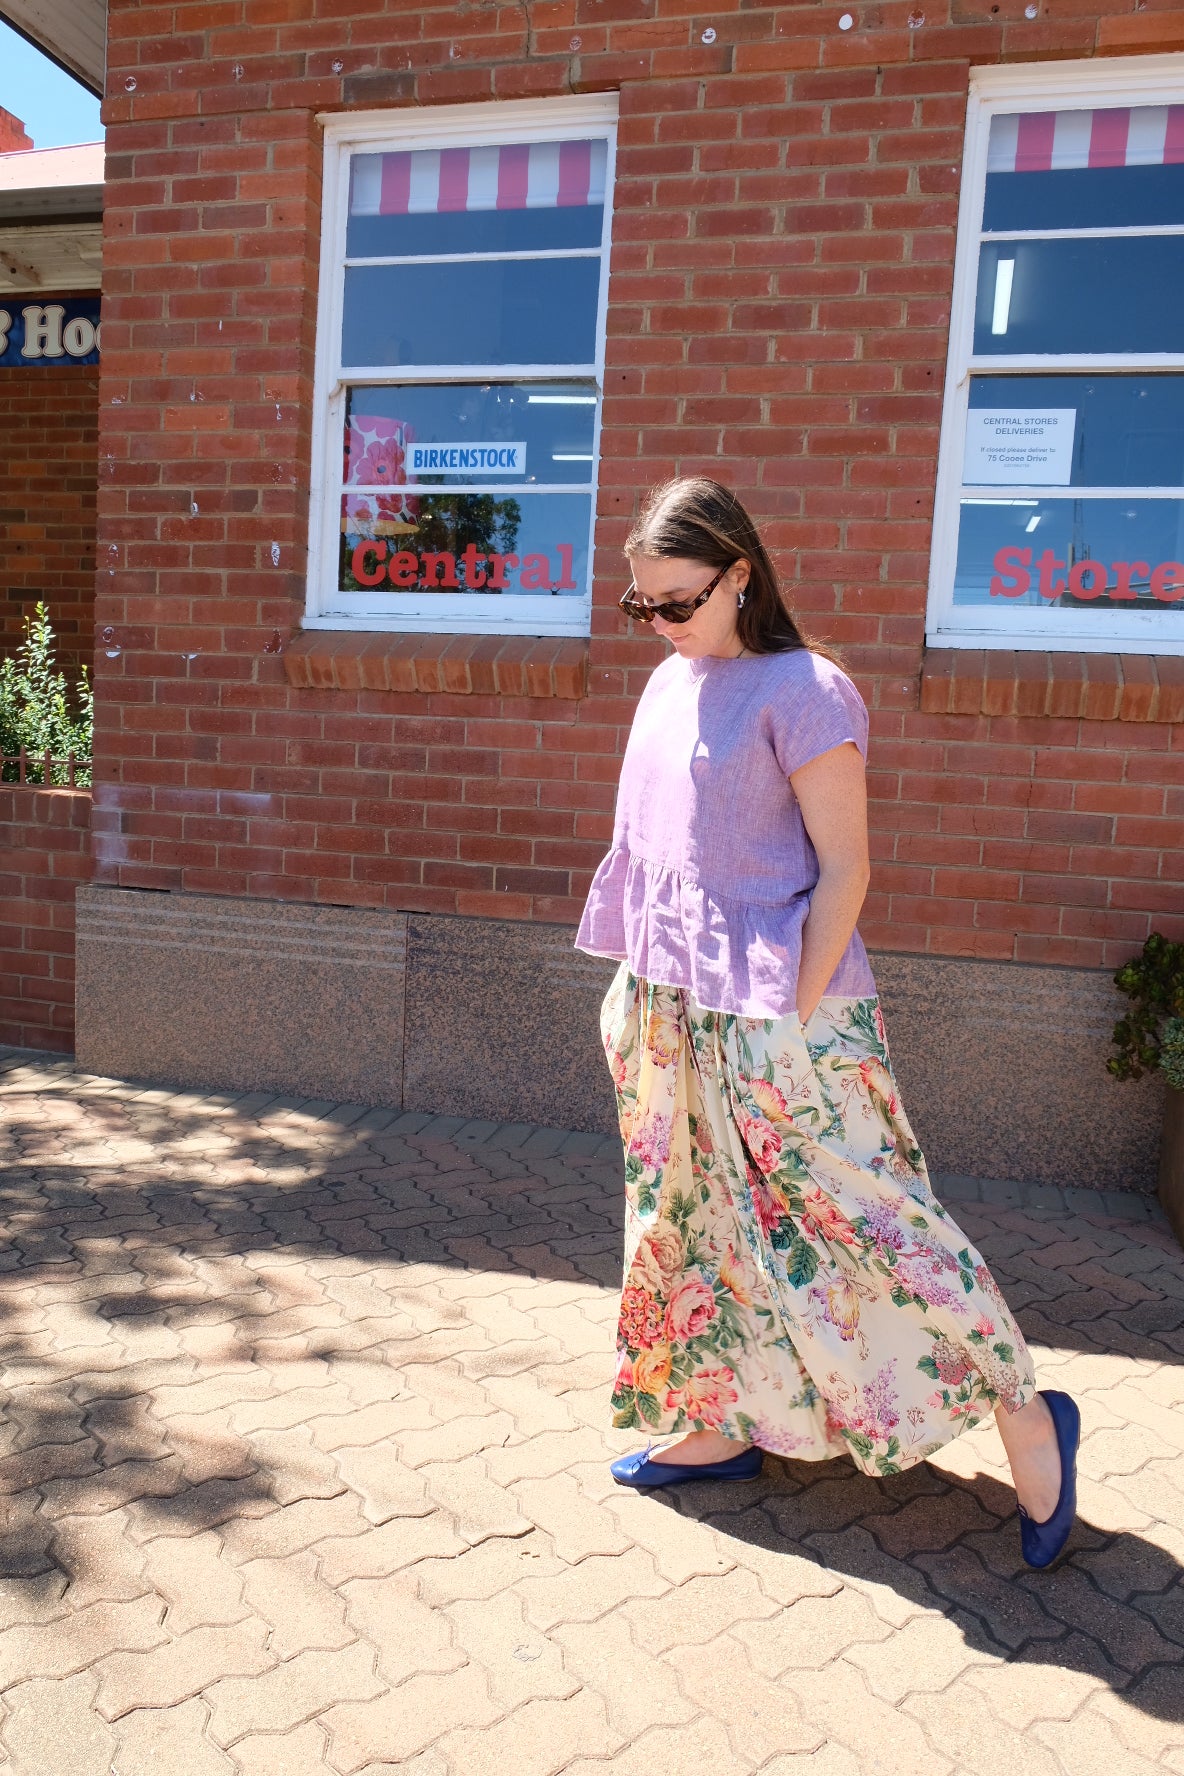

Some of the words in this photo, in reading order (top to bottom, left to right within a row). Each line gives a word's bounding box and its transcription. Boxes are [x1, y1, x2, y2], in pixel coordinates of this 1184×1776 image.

[21, 305, 102, 358] Ho
[983, 417, 1022, 425] CENTRAL
[1024, 417, 1059, 425] STORES
[995, 427, 1045, 435] DELIVERIES
[1007, 446, 1027, 454] please
[413, 448, 517, 469] BIRKENSTOCK
[987, 454, 998, 462] 75
[998, 454, 1025, 462] Cooee
[1026, 454, 1048, 462] Drive
[351, 539, 577, 590] Central
[989, 545, 1184, 602] Store
